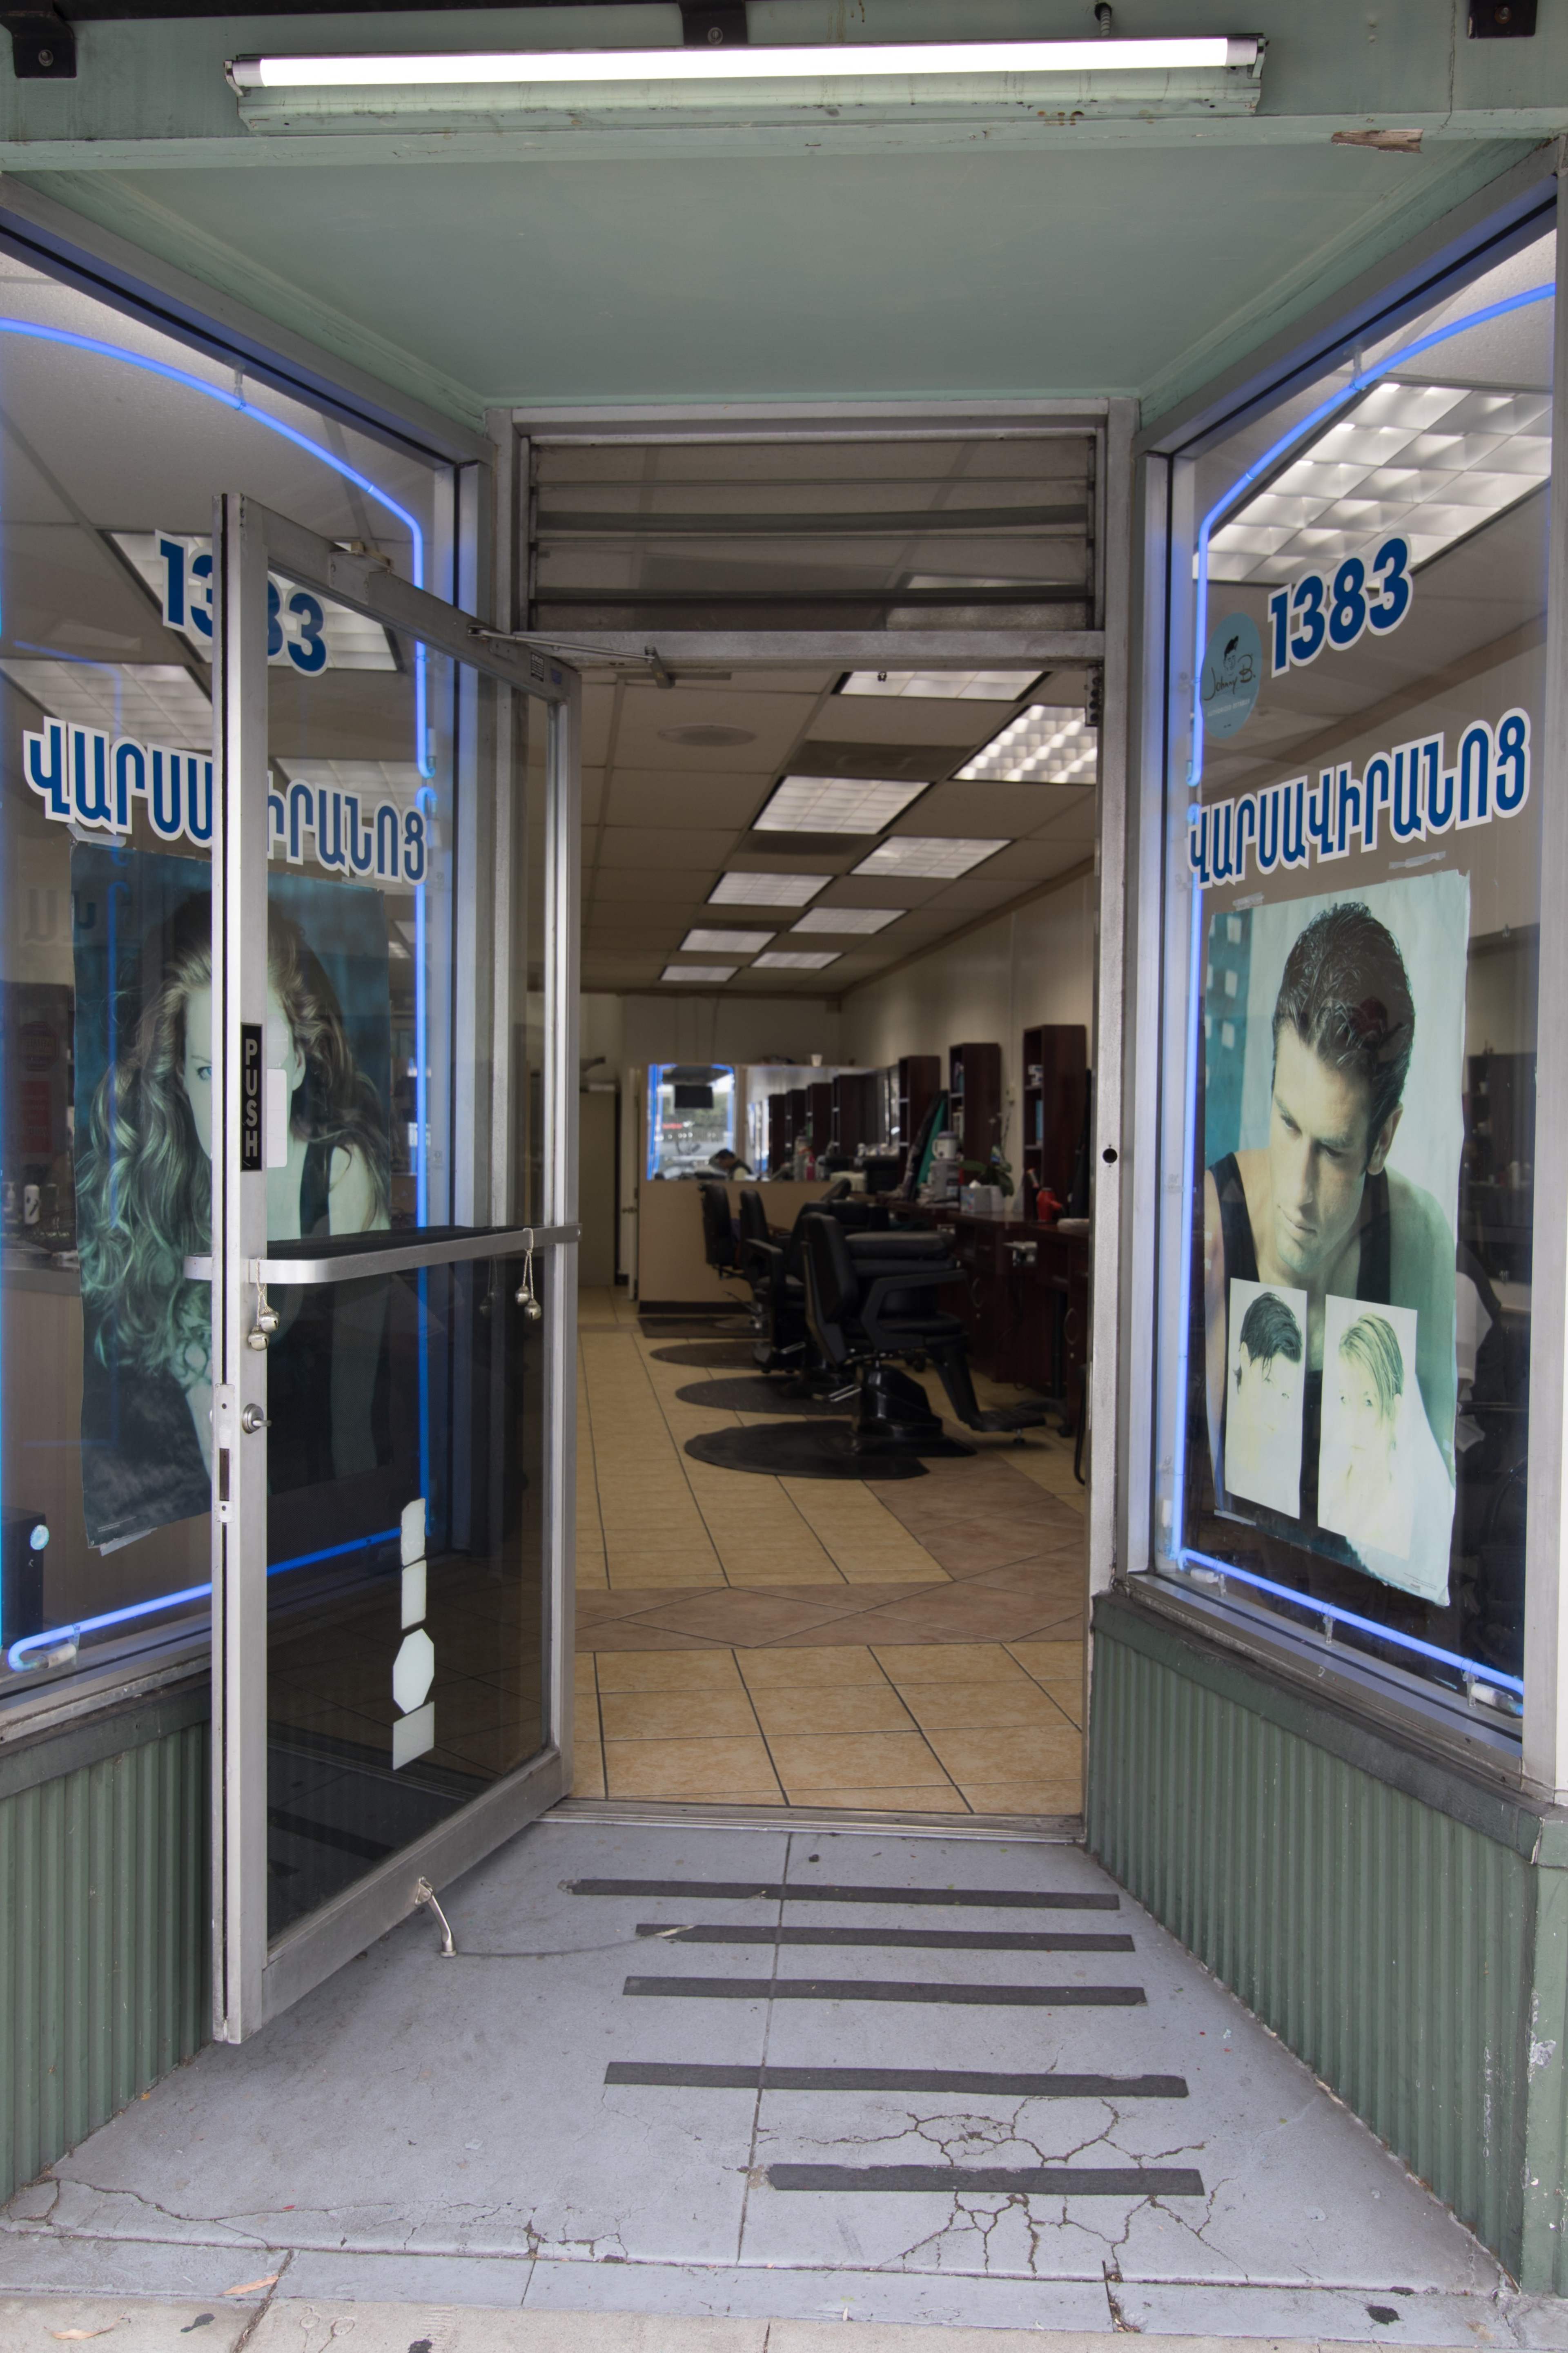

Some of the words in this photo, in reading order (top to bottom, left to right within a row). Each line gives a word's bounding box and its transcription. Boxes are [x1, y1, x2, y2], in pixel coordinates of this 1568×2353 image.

[1271, 537, 1409, 671] 1383
[1203, 667, 1238, 701] Johnny
[1238, 654, 1256, 683] B.
[30, 725, 425, 881] ՎԱՐՍԱԻՐԱՆՈՑ
[1190, 715, 1526, 883] ՎԱՐՍԱՎԻՐԱՆՈՑ
[245, 1038, 258, 1157] PUSH
